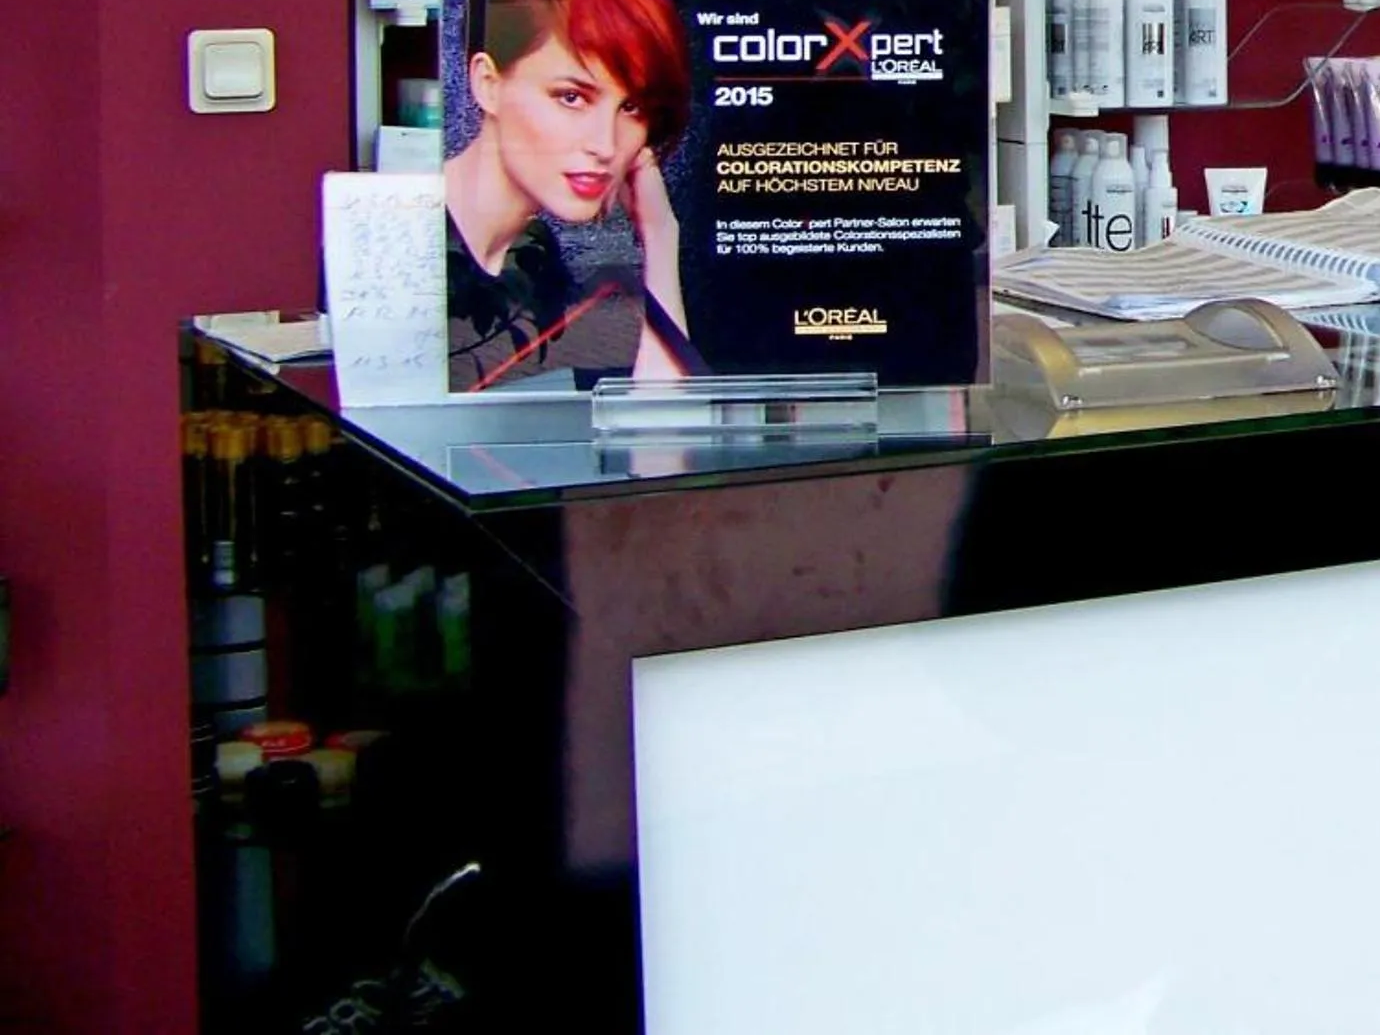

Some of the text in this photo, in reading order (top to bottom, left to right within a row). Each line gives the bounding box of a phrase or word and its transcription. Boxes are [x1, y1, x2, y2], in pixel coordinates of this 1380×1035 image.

[697, 13, 759, 25] Wir sind
[871, 58, 943, 74] L'ORÉAL
[714, 86, 774, 106] 2015
[717, 138, 898, 157] AUSGEZEICHNET FÜR
[717, 159, 961, 175] COLORATIONSKOMPETENZ
[717, 176, 920, 193] AUF HÖCHSTEM NIVEAU
[735, 243, 770, 254] 100%
[795, 306, 887, 326] L'ORÉAL
